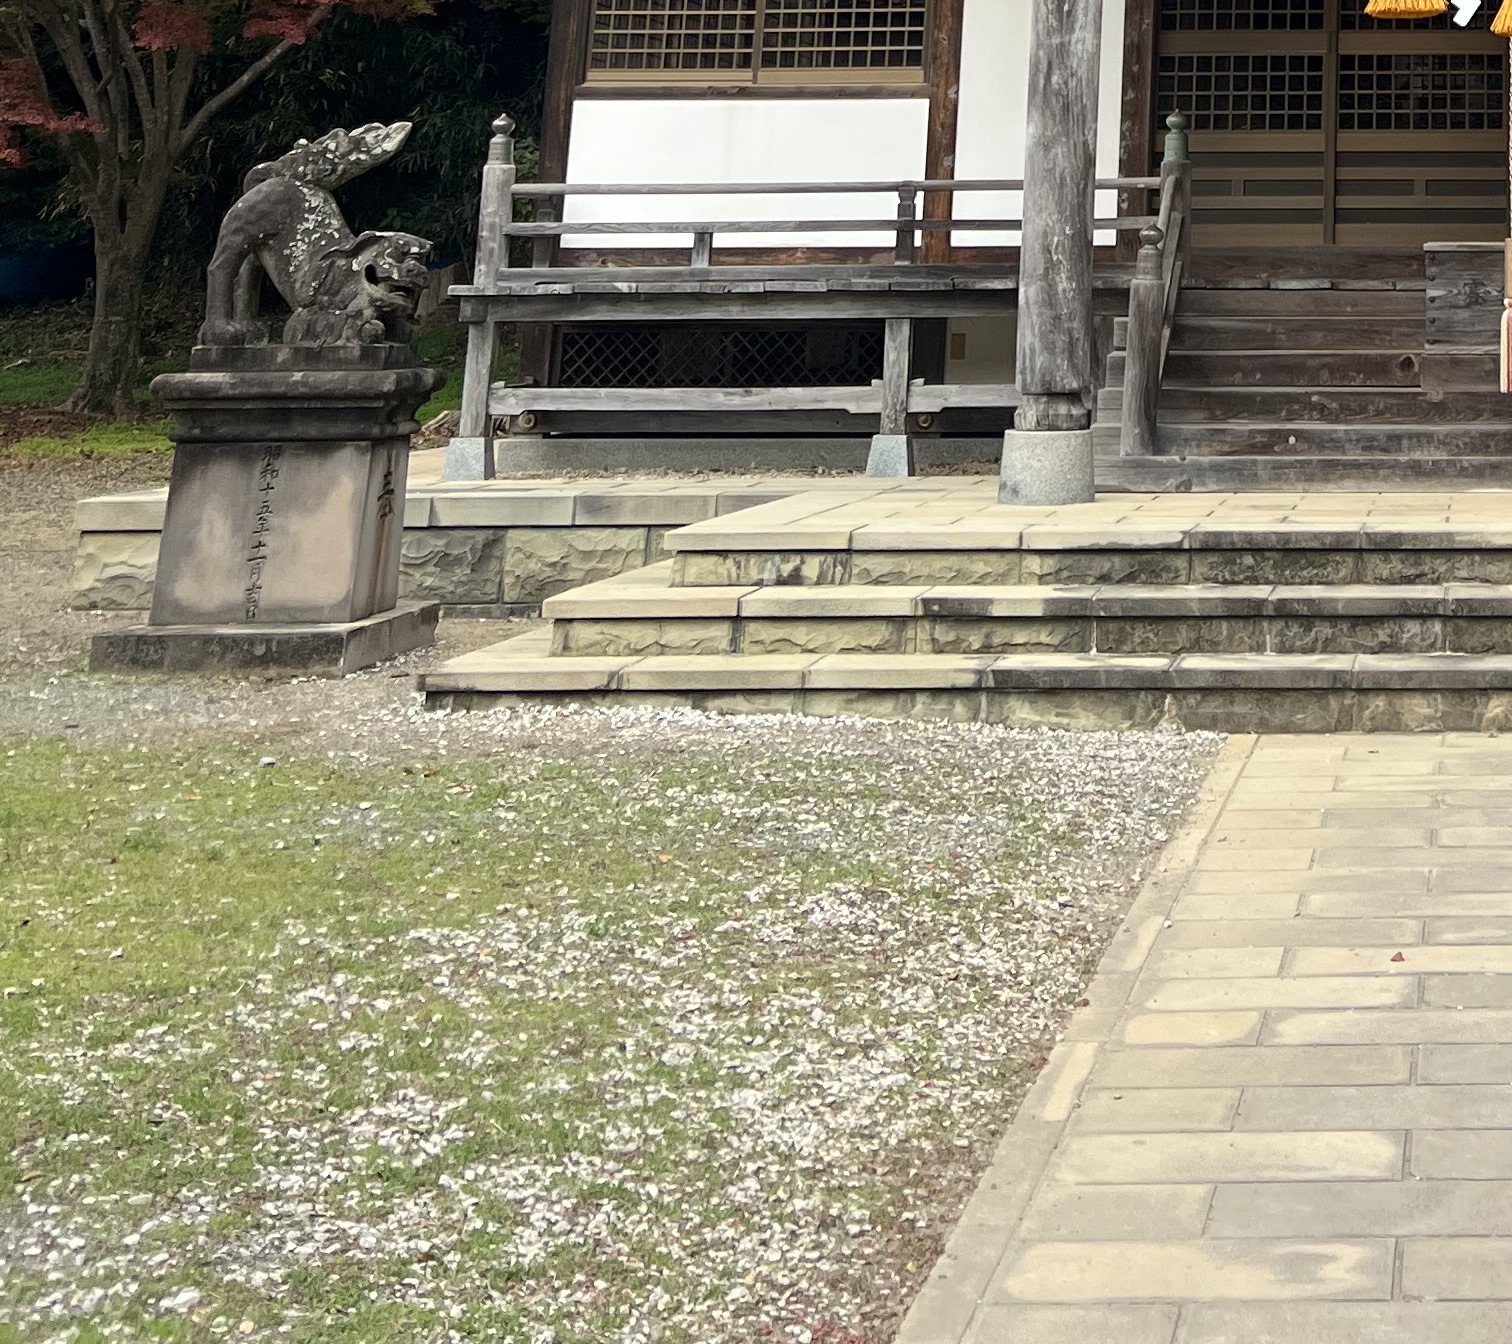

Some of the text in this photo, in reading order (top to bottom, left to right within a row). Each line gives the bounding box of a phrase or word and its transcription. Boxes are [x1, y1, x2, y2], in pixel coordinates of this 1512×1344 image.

[244, 445, 283, 621] 昭和十五年十一月吉日
